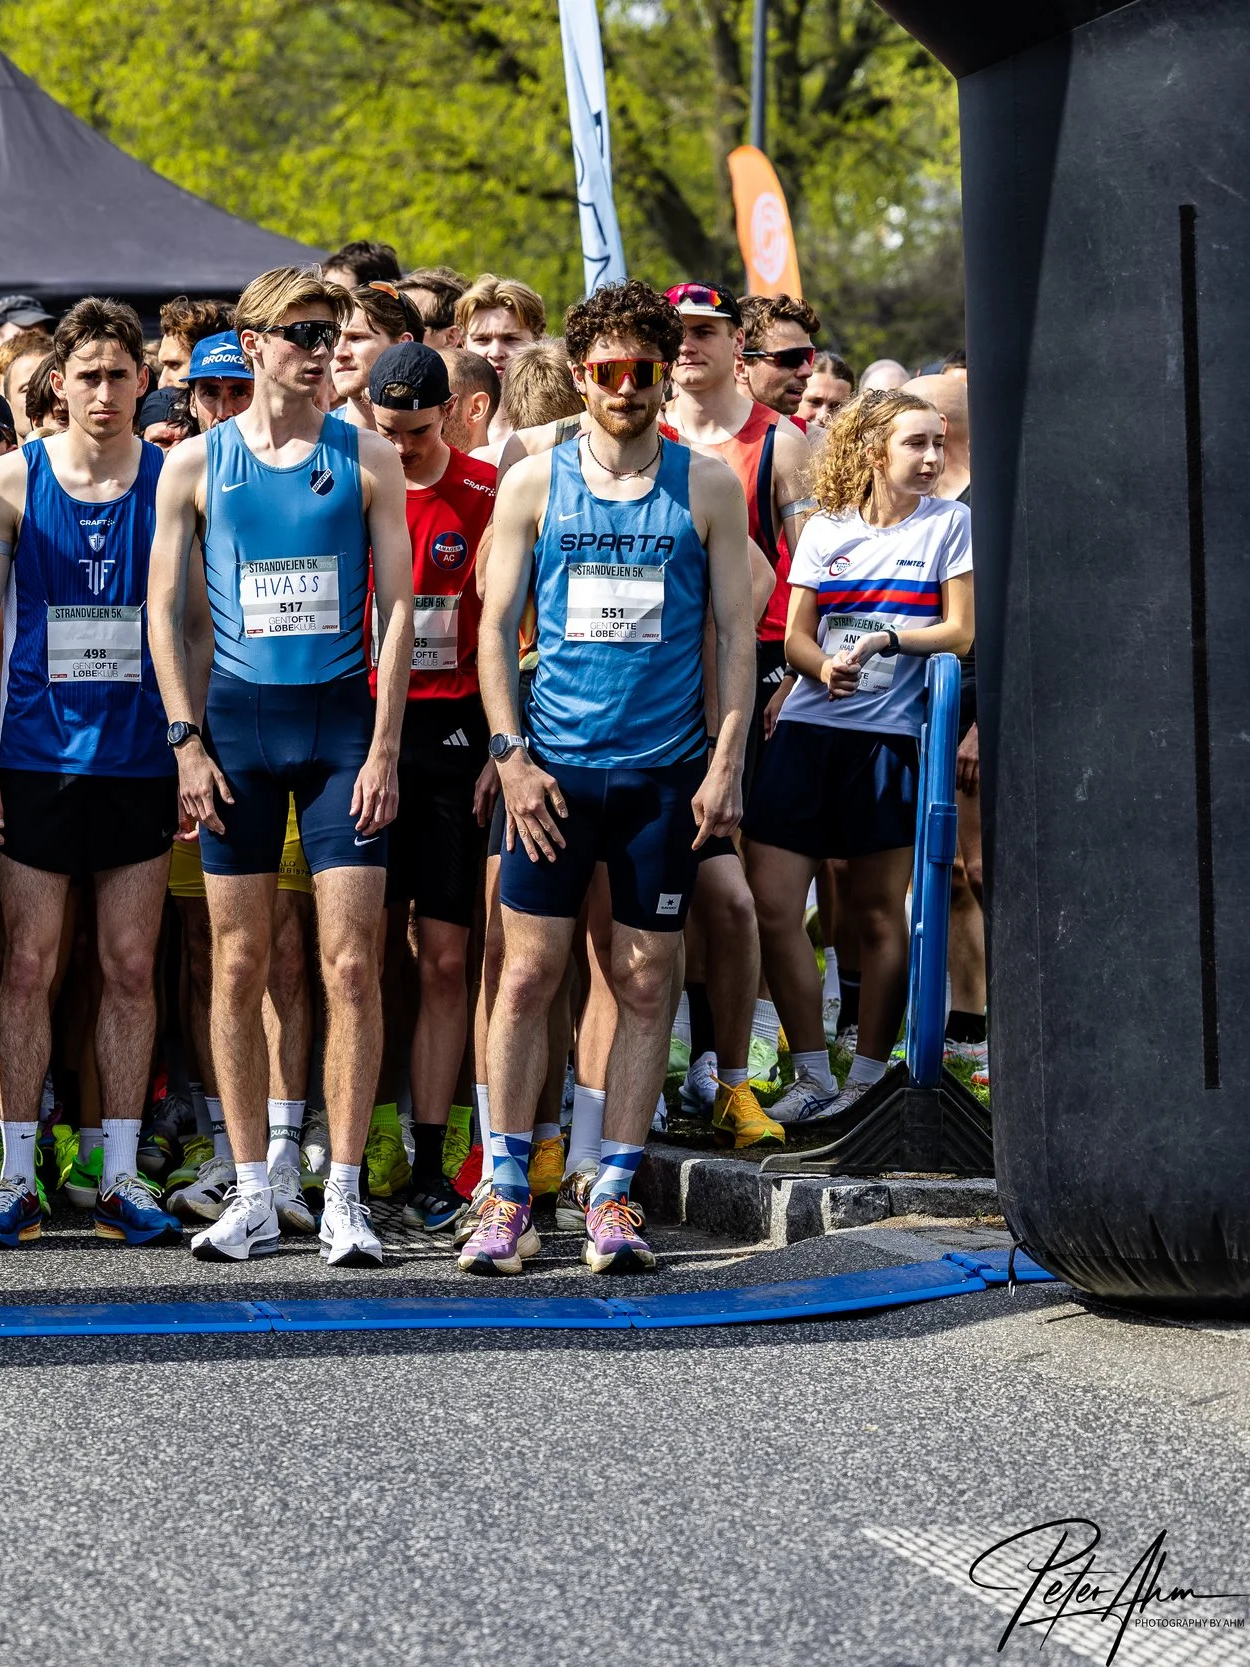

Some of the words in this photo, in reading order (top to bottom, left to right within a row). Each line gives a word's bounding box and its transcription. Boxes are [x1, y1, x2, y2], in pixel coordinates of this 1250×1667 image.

[202, 354, 245, 366] BROOKS
[463, 479, 490, 493] CRAFT
[560, 533, 675, 554] SPARTA
[443, 554, 455, 562] AC
[249, 559, 305, 573] STRANDVEJEN
[307, 558, 318, 569] 5K
[896, 559, 926, 568] TRIMTEX
[576, 565, 630, 577] STRANDVEJEN
[632, 567, 644, 577] 5K
[255, 575, 319, 598] HVASS
[414, 597, 434, 607] EJEN
[435, 597, 446, 607] 5K
[280, 602, 303, 613] 517
[55, 608, 109, 619] STRANDVEJEN
[111, 608, 122, 618] 5K
[601, 608, 624, 619] 551
[269, 615, 315, 625] GENTOFTE
[269, 623, 316, 632] LØBEKLUB
[590, 621, 637, 630] GENTOFTE
[590, 630, 637, 638] LØBEKLUB
[83, 649, 107, 659] 498
[72, 662, 118, 670] GENTOFTE
[73, 670, 118, 678] LØBEKLUB
